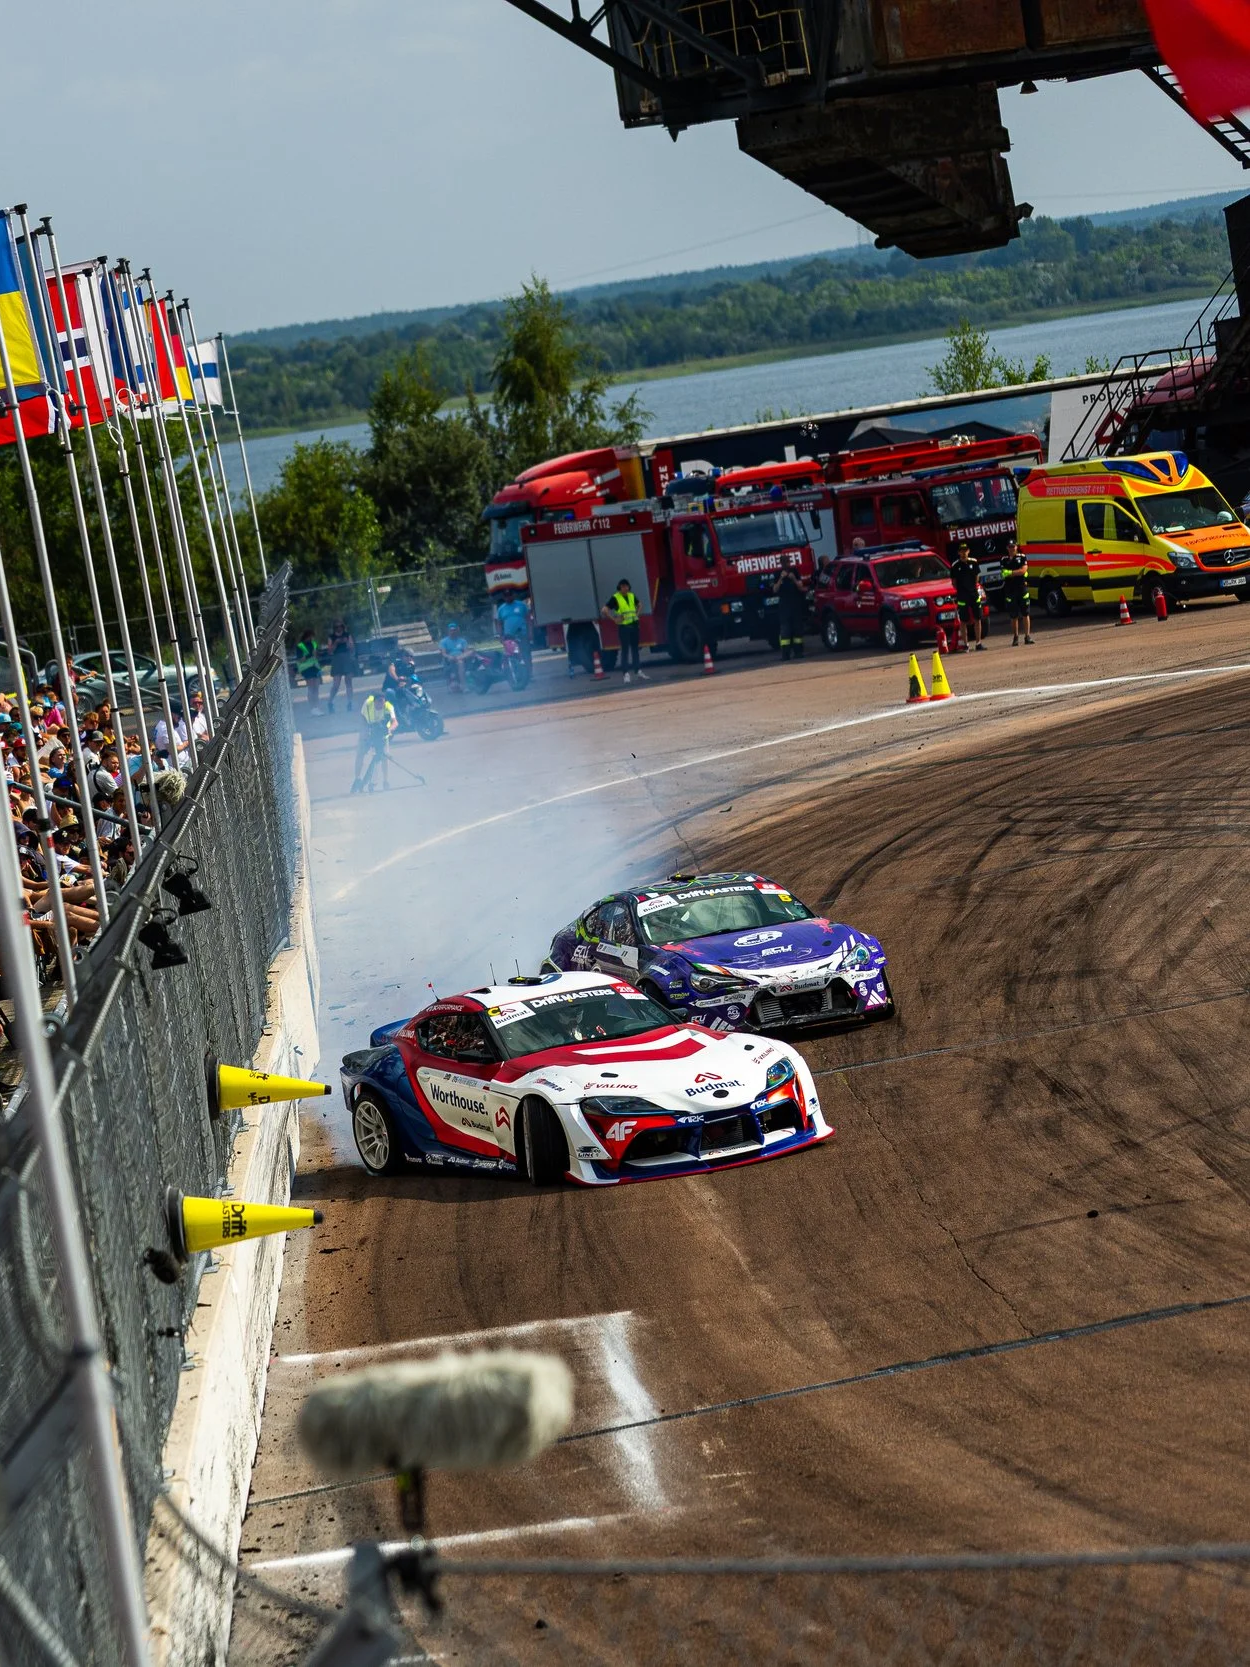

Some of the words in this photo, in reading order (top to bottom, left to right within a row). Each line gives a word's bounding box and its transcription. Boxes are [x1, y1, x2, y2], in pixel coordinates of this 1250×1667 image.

[553, 520, 591, 535] FEUERWEHR
[598, 518, 610, 529] 112
[949, 520, 1017, 541] FEUERWEH
[574, 945, 591, 959] ECU
[487, 1007, 500, 1017] C
[430, 1083, 489, 1116] Worthouse.
[231, 1204, 247, 1238] Drift
